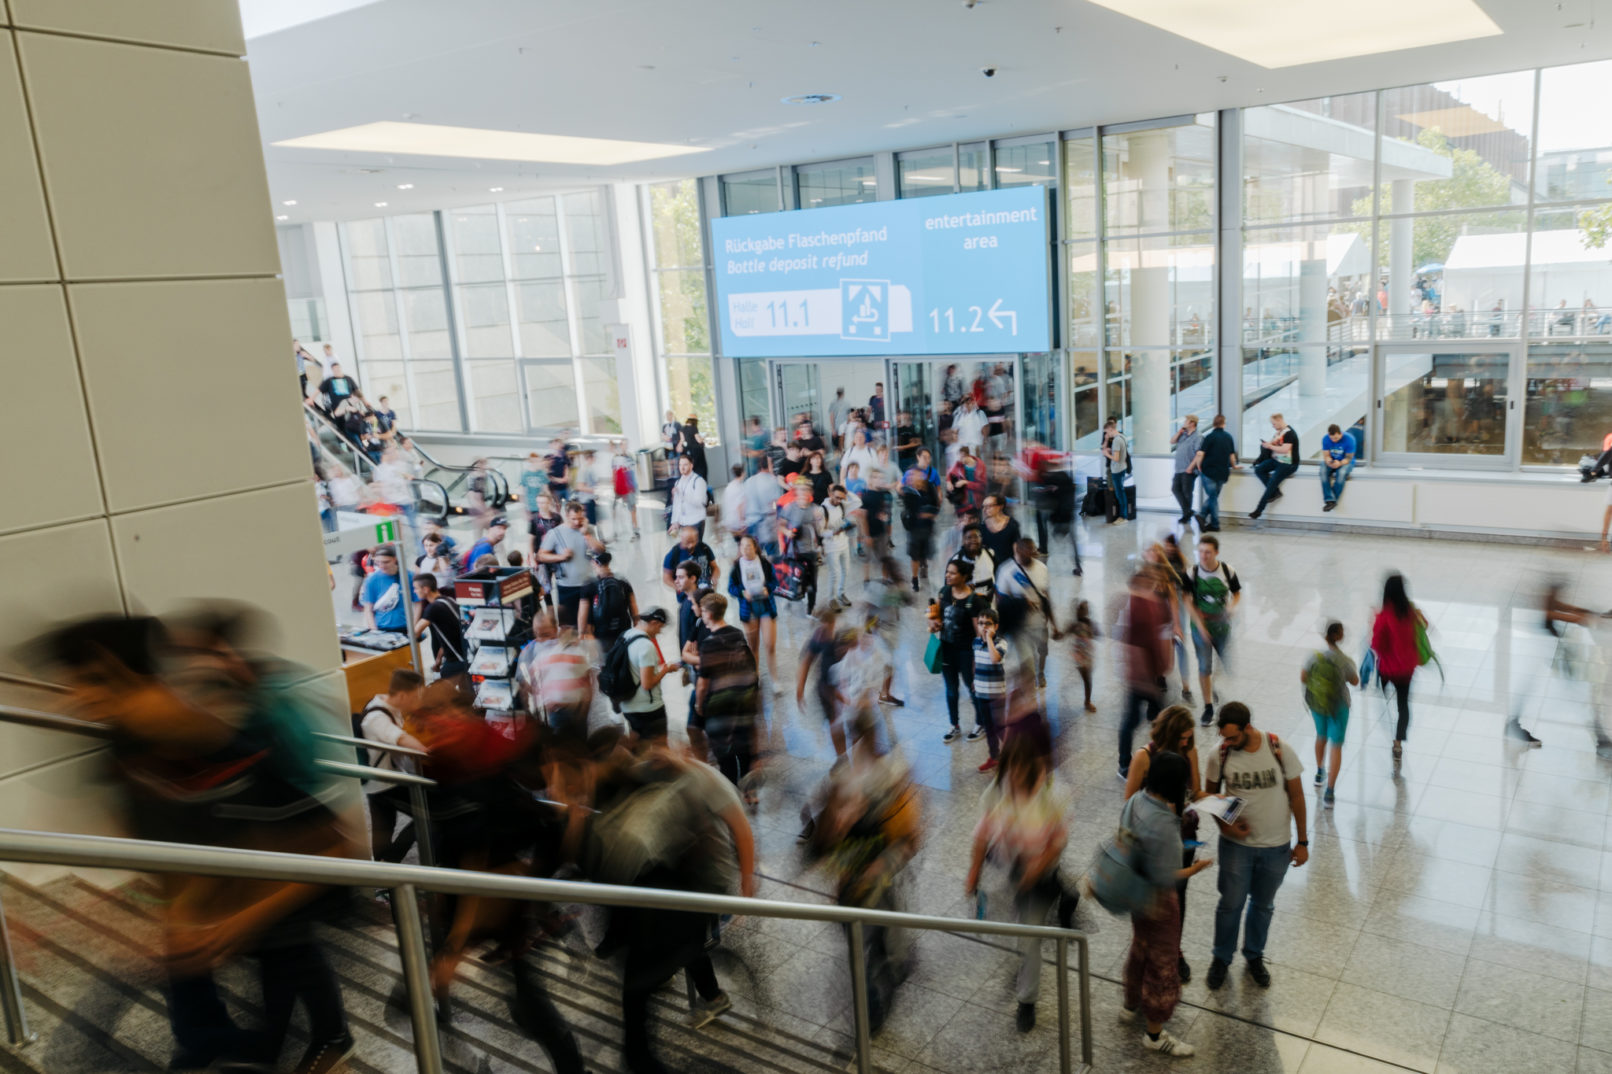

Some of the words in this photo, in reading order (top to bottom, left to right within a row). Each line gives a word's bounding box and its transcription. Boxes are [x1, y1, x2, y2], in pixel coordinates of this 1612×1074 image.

[925, 207, 1037, 230] entertainment
[726, 236, 785, 255] Rückgabe
[788, 226, 888, 249] Flaschenpfand
[963, 234, 998, 250] area
[727, 257, 766, 274] Bottle
[769, 253, 818, 274] deposit
[822, 250, 869, 270] refund
[733, 300, 758, 313] Halle
[766, 299, 809, 328] 11.1
[735, 317, 755, 329] Hall
[929, 305, 984, 334] 11.2
[1231, 768, 1277, 790] AGAIN
